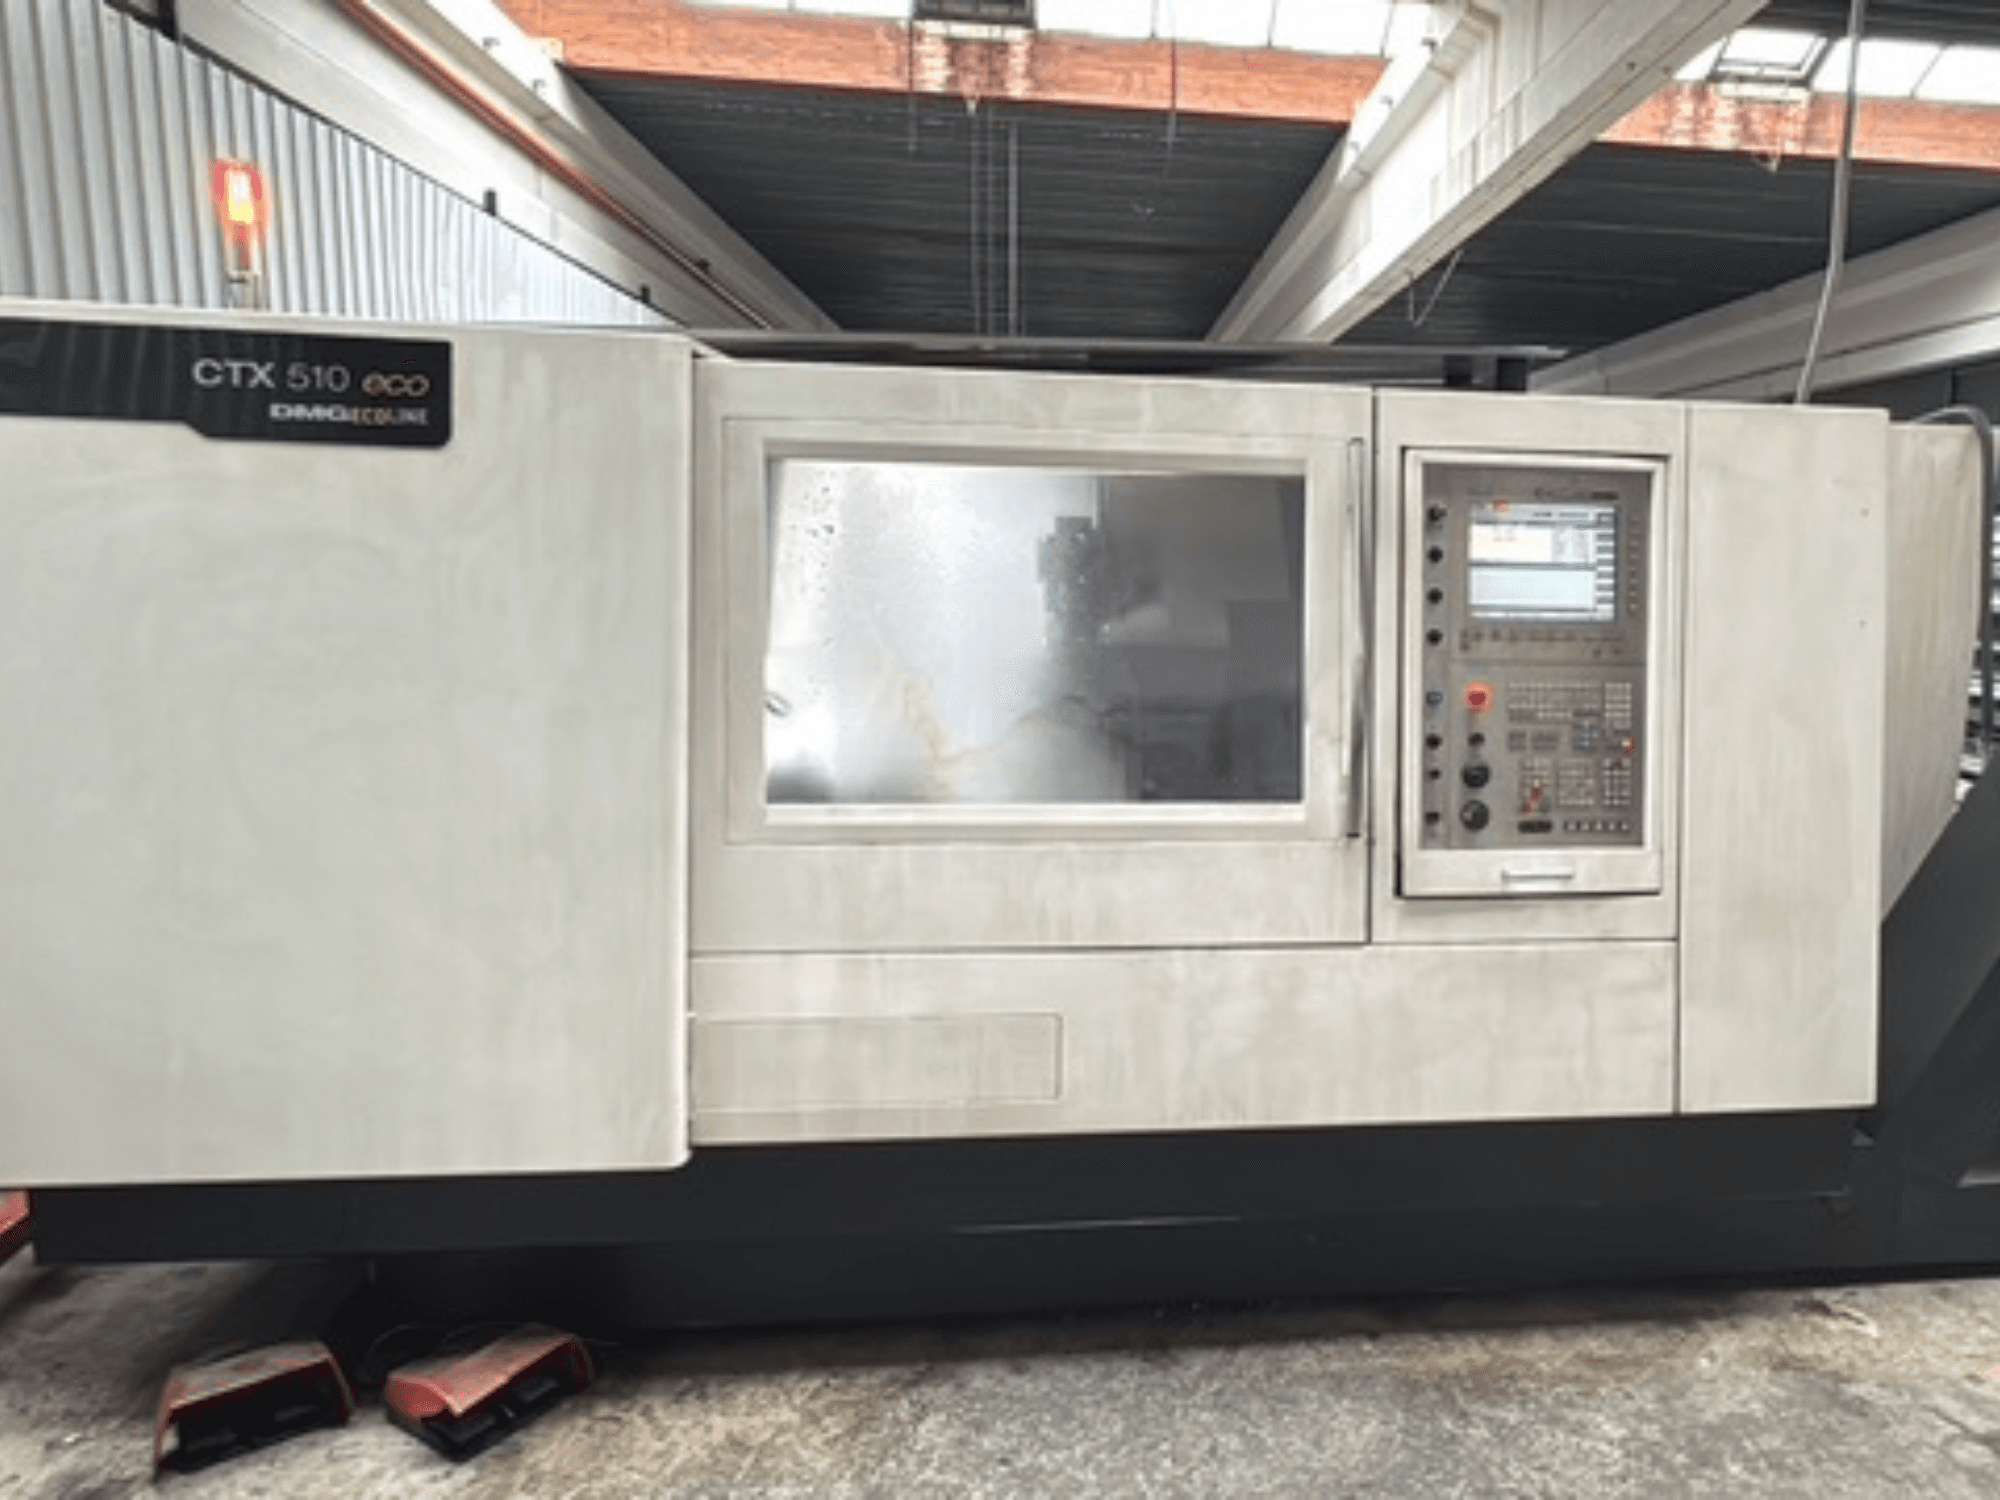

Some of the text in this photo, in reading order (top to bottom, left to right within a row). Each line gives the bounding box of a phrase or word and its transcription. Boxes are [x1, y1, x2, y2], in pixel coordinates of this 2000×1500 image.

[192, 357, 430, 397] CTX 510 eco
